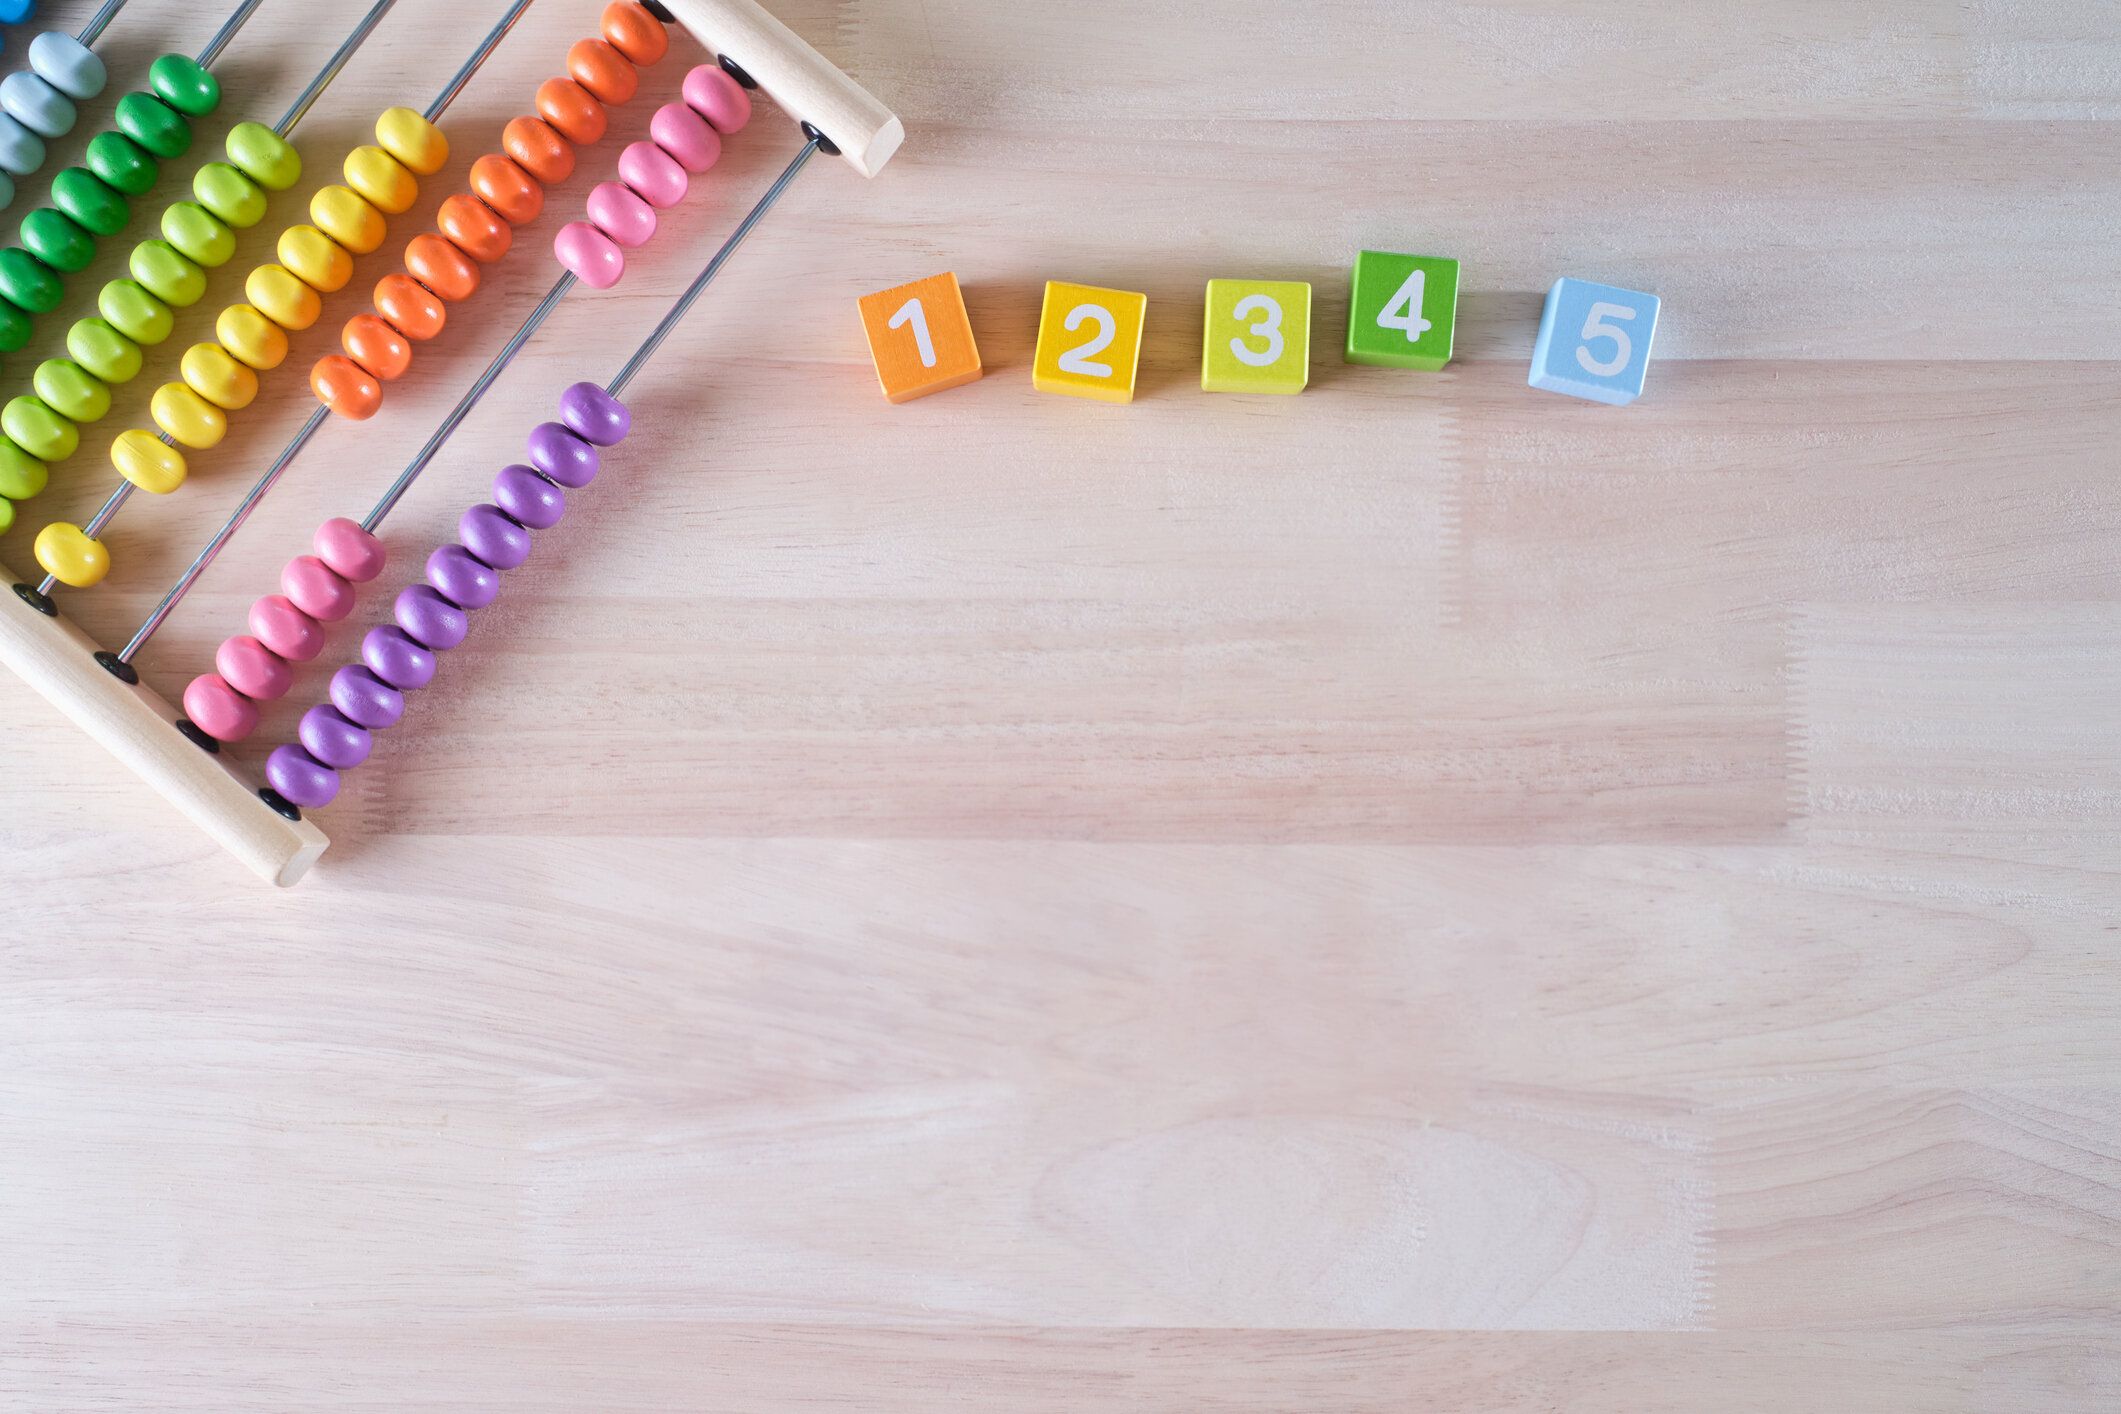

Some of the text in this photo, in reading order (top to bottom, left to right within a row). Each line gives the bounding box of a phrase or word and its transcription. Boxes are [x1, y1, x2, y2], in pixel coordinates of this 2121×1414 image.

[887, 297, 937, 369] 1
[1057, 303, 1117, 378] 2
[1230, 294, 1284, 368] 3
[1376, 269, 1432, 343] 4
[1575, 302, 1637, 377] 5
